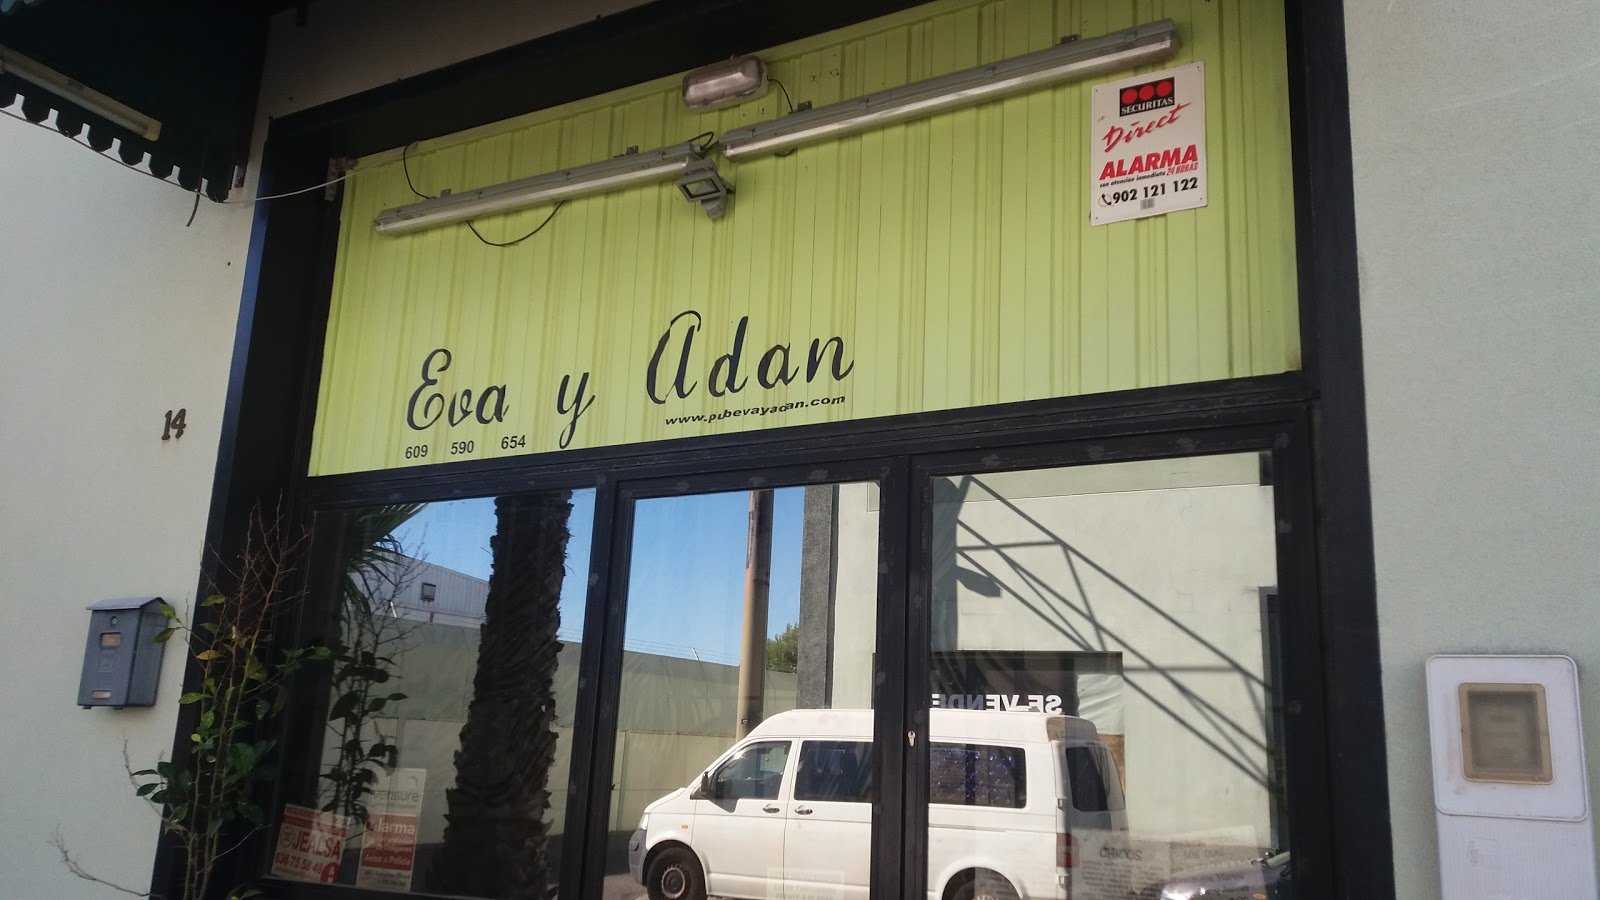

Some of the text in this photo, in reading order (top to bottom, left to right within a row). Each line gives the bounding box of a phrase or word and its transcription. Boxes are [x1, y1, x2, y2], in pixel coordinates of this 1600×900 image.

[1121, 97, 1174, 115] SECURITAS
[1101, 102, 1192, 153] Direct
[1099, 144, 1198, 180] ALARMA
[1166, 166, 1176, 176] 24
[1176, 161, 1199, 175] HORAS
[1113, 176, 1198, 204] 902 121 122
[406, 310, 854, 449] Eva y Adan
[161, 408, 187, 441] 14
[405, 434, 527, 459] 609 590 654
